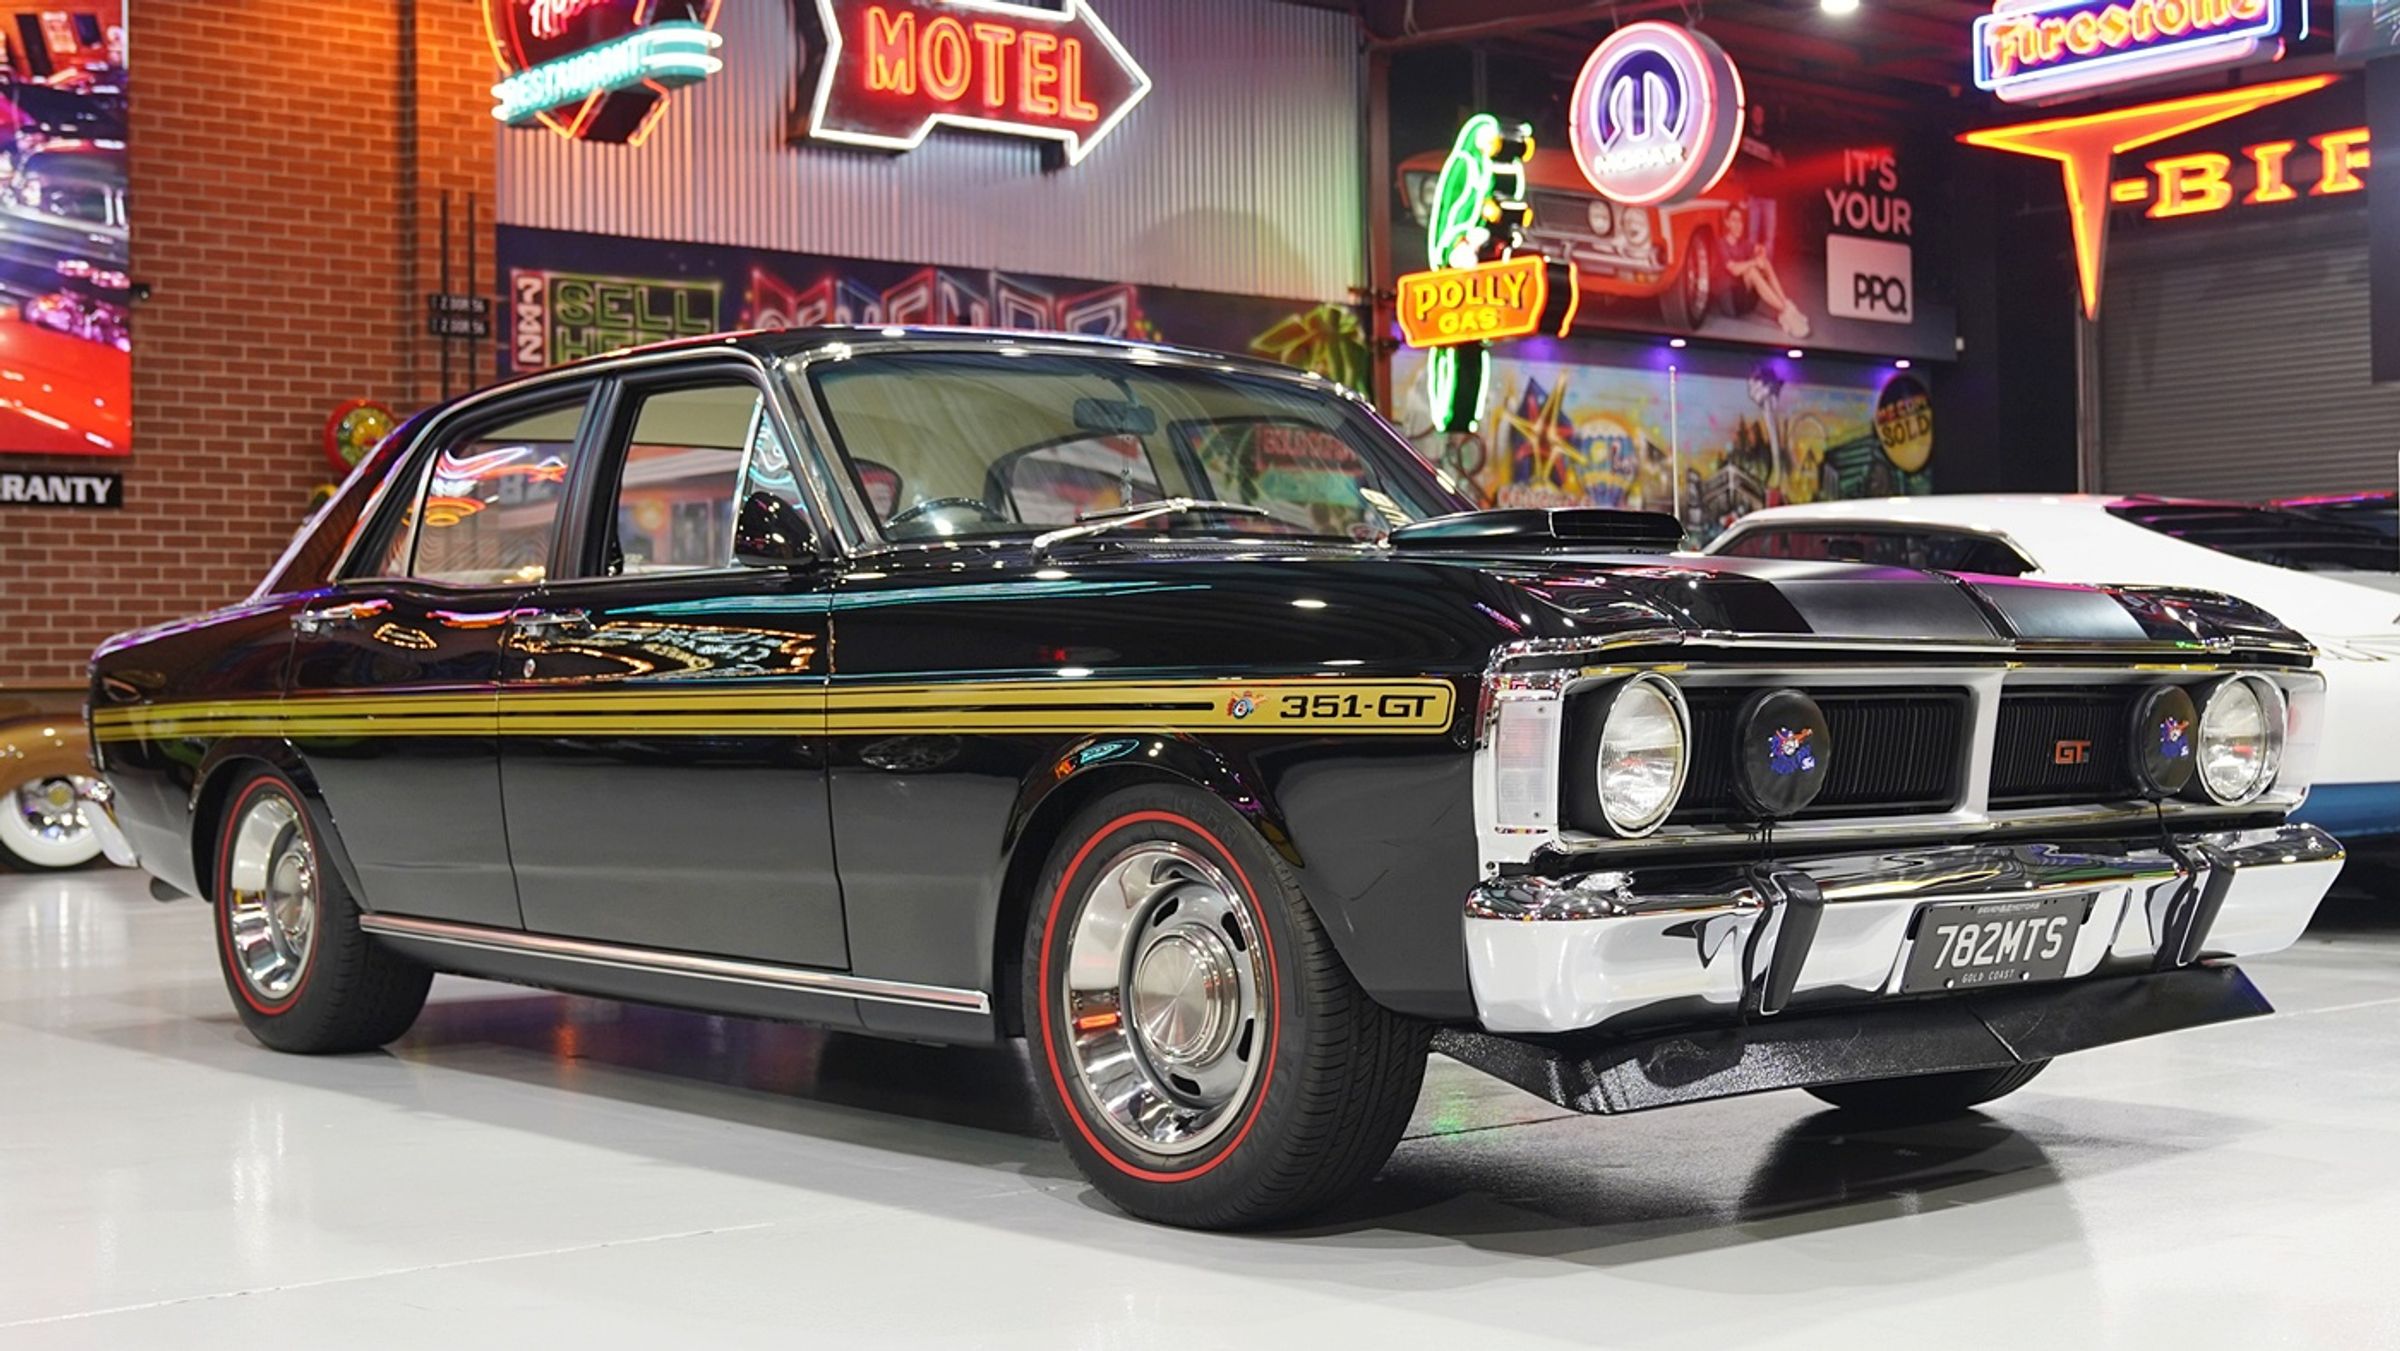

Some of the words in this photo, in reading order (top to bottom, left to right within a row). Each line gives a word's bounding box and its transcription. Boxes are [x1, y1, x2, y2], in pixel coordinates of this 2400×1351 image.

[1987, 0, 2265, 78] Firestone
[866, 6, 1099, 121] MOTEL
[1844, 149, 1897, 191] IT'S
[1825, 188, 1912, 235] YOUR
[556, 279, 712, 334] SELL
[1413, 271, 1528, 320] POLLY
[1854, 272, 1907, 315] PPQ
[1438, 307, 1499, 333] GAS
[1882, 413, 1930, 448] SOLD
[0, 474, 112, 504] RANTY
[1280, 694, 1436, 719] 351-GT
[2055, 740, 2091, 764] GT
[1933, 915, 2068, 970] 782MTS
[1961, 972, 1985, 984] GOLD
[1988, 969, 2016, 981] COAST
